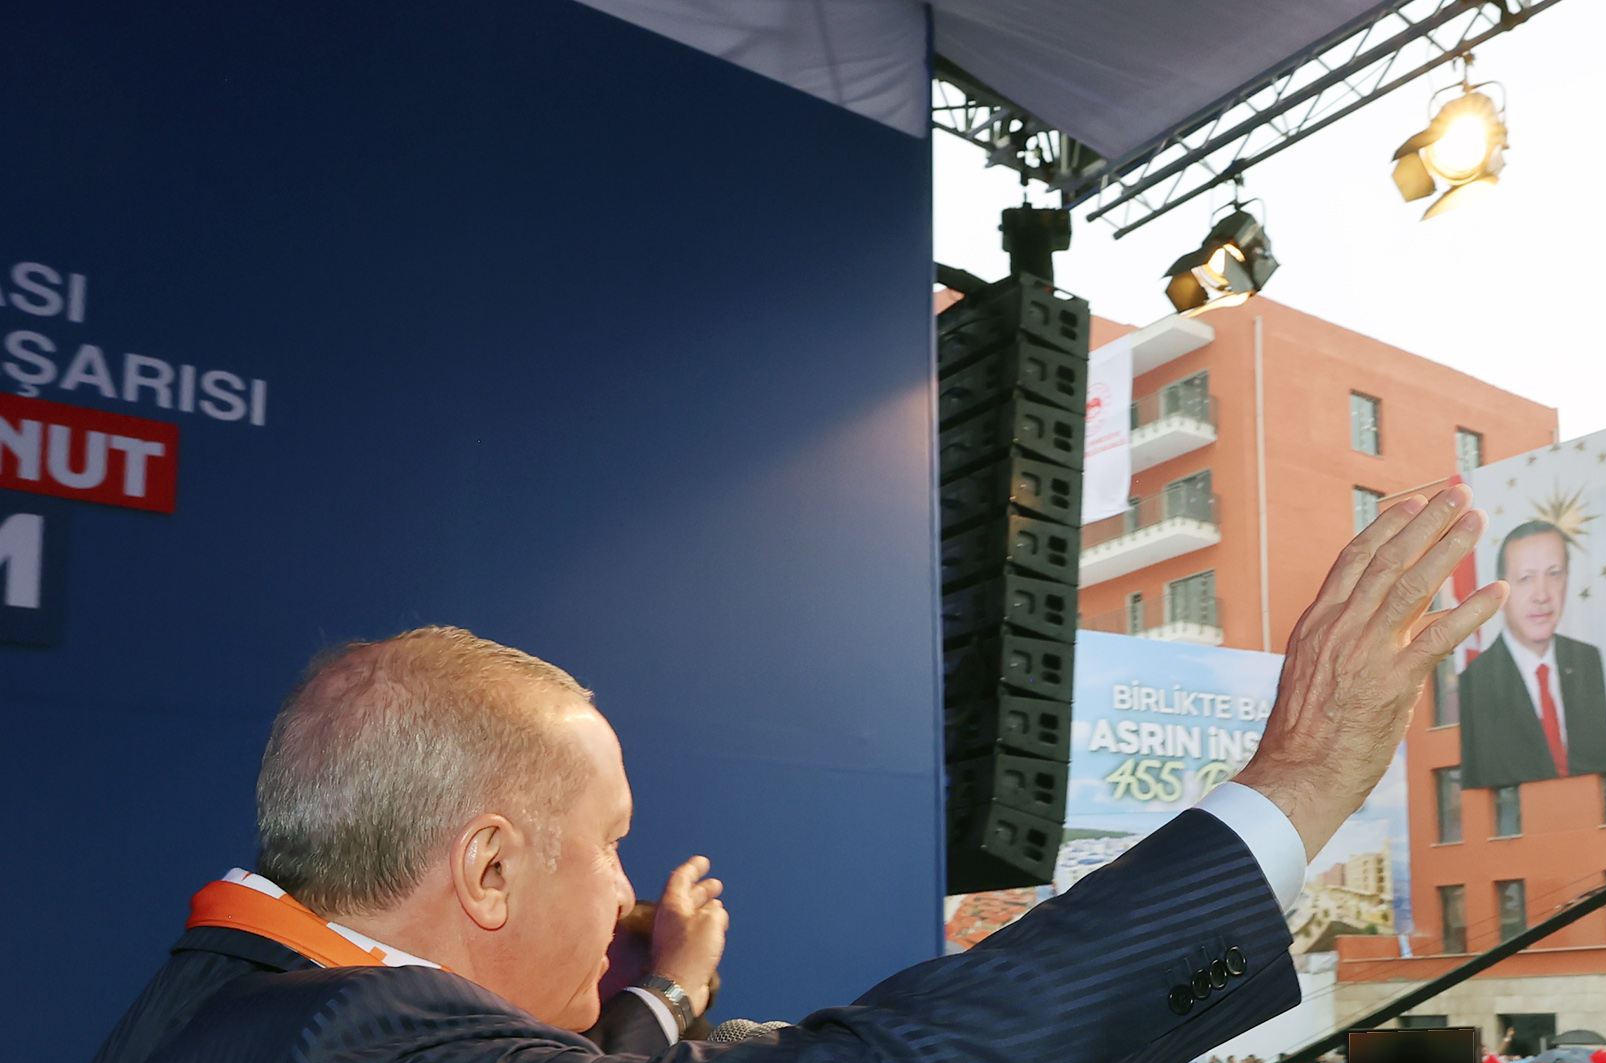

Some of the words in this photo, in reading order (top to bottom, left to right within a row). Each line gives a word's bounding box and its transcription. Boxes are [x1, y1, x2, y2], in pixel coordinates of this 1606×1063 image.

[0, 262, 87, 323] SI
[3, 330, 267, 426] ŞARISI
[1113, 679, 1232, 719] BİRLİKTE
[1089, 719, 1201, 758] ASRIN
[1104, 759, 1185, 801] 455
